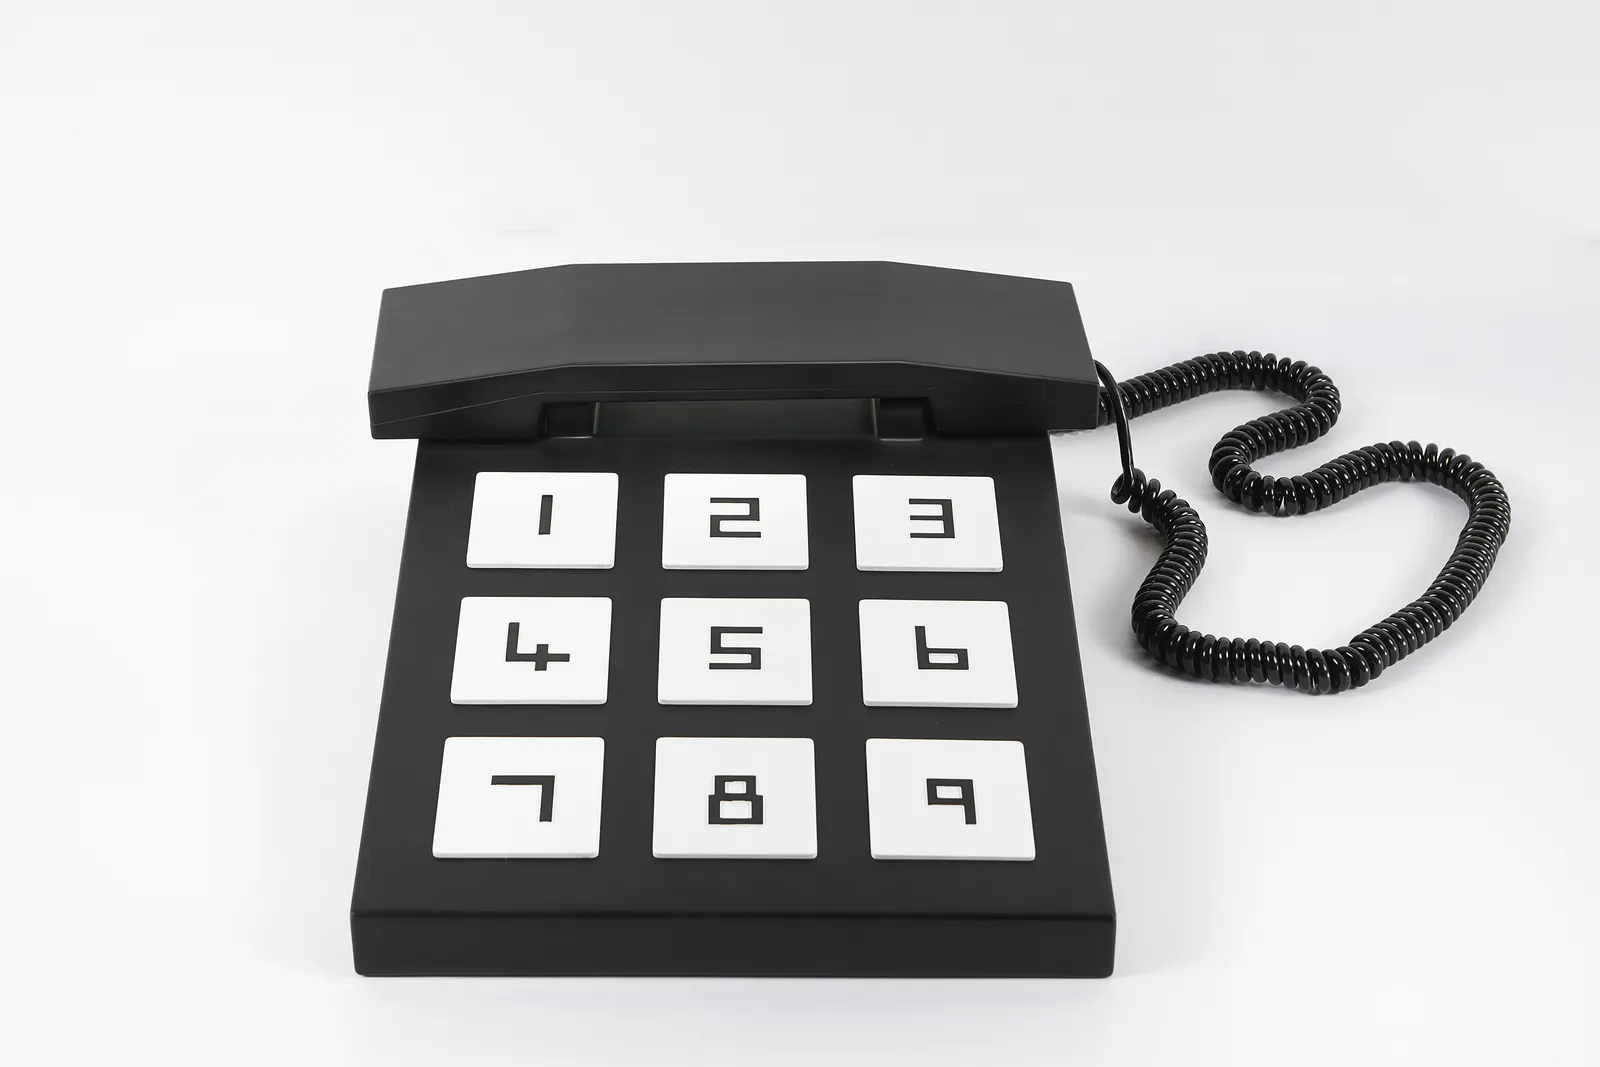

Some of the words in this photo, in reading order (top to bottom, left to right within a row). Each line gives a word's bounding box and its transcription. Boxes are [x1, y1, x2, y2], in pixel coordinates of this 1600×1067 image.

[538, 494, 554, 536] 1
[709, 497, 762, 539] 2
[908, 498, 956, 539] 3
[505, 621, 571, 672] 4
[708, 626, 764, 671] 5
[914, 625, 970, 671] 6
[490, 774, 556, 823] 7
[707, 774, 764, 826] 8
[925, 778, 977, 825] 9
